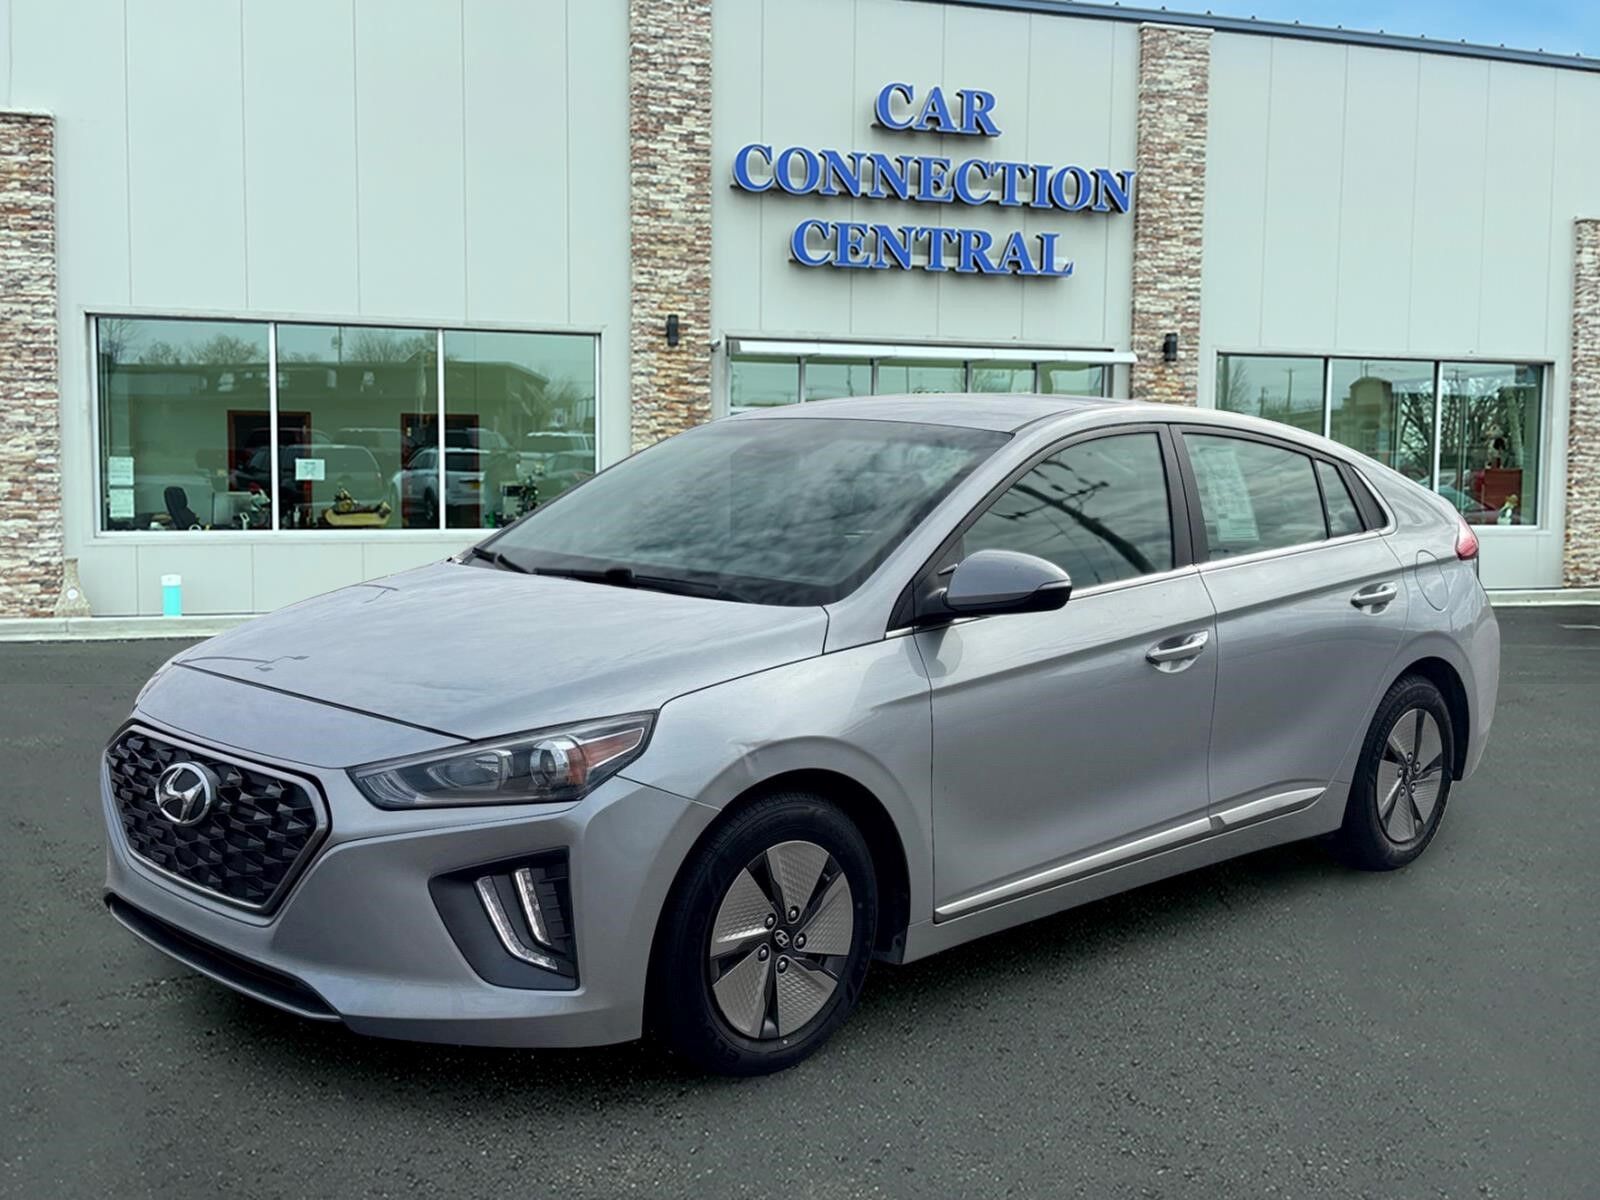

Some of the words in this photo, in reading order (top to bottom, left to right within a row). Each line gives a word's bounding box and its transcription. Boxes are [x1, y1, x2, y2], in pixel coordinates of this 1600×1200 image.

[875, 82, 1000, 135] CAR
[733, 143, 1135, 214] CONNECTION
[790, 219, 1074, 277] CENTRAL
